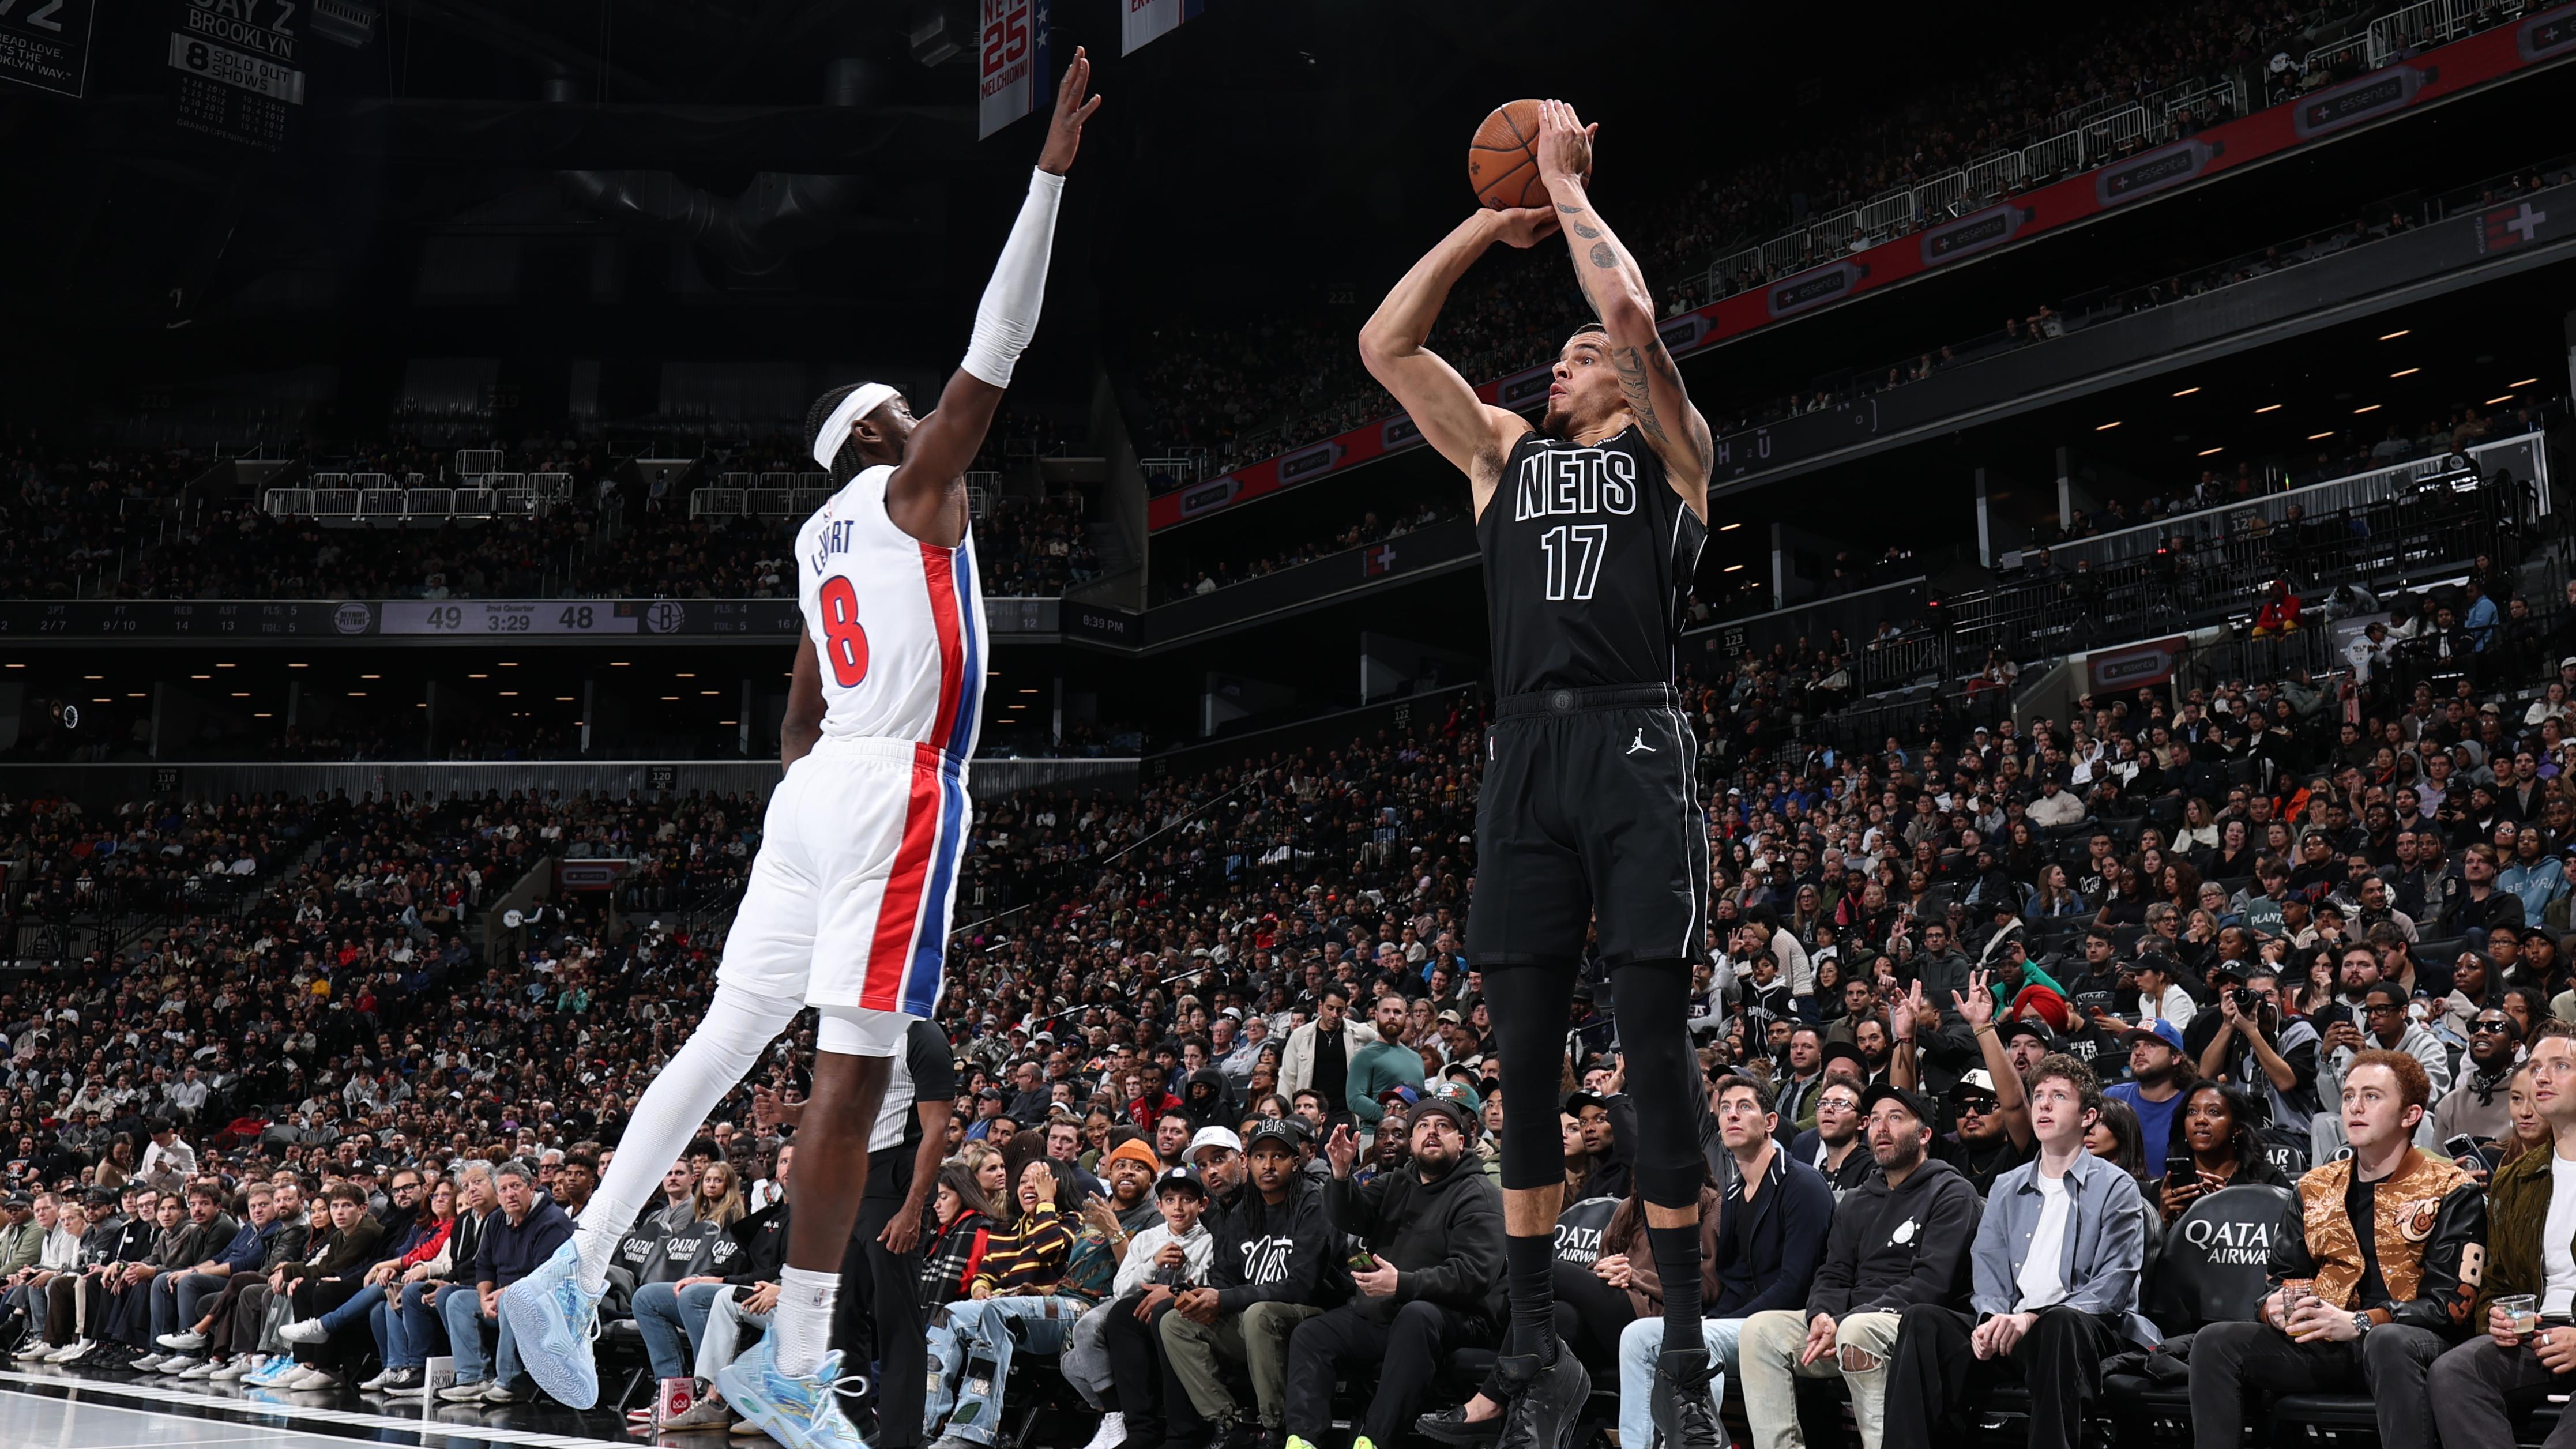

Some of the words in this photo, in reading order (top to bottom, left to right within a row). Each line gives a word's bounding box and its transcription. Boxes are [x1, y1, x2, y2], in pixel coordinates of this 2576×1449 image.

[189, 9, 292, 58] BROOKLYN
[983, 5, 1027, 78] 25
[0, 33, 27, 48] EAD
[30, 42, 63, 59] LOVE,
[18, 49, 42, 63] THE
[186, 42, 209, 71] 8
[214, 51, 253, 72] SOLD
[260, 65, 289, 82] OUT
[212, 65, 268, 91] SHOWS
[981, 59, 1028, 100] MELCHIONNI
[2340, 82, 2397, 111] essentia
[176, 118, 208, 133] GRAND
[210, 128, 249, 145] OPENING
[2137, 158, 2187, 182] essentia
[1957, 221, 2002, 243] essentia
[1800, 277, 1841, 296] essentia
[1661, 328, 1692, 342] ssentia
[1515, 448, 1637, 522] NETS
[2230, 508, 2256, 519] SECTION
[1541, 524, 1608, 601] 17
[219, 606, 238, 615] AST
[290, 606, 298, 615] 5
[427, 607, 462, 630] 49
[559, 607, 593, 629] 48
[503, 605, 535, 613] Quarter
[175, 621, 189, 631] 14
[221, 620, 235, 631] 13
[288, 623, 296, 633] 5
[488, 615, 530, 631] 3:29
[819, 575, 870, 688] 8
[1024, 619, 1037, 628] 12
[1108, 620, 1123, 633] PM
[1725, 634, 1743, 647] 123
[1730, 647, 1739, 656] 23
[2123, 659, 2156, 673] essentia
[1395, 709, 1409, 720] 122
[157, 774, 176, 782] 118
[1554, 1224, 1602, 1250] QATA
[2184, 1220, 2280, 1250] QATA
[623, 1238, 655, 1255] QATAR
[667, 1237, 701, 1254] QATAR
[668, 1252, 694, 1261] AIRWAYS
[2208, 1249, 2271, 1266] AIRWA
[2458, 1241, 2485, 1287] 8
